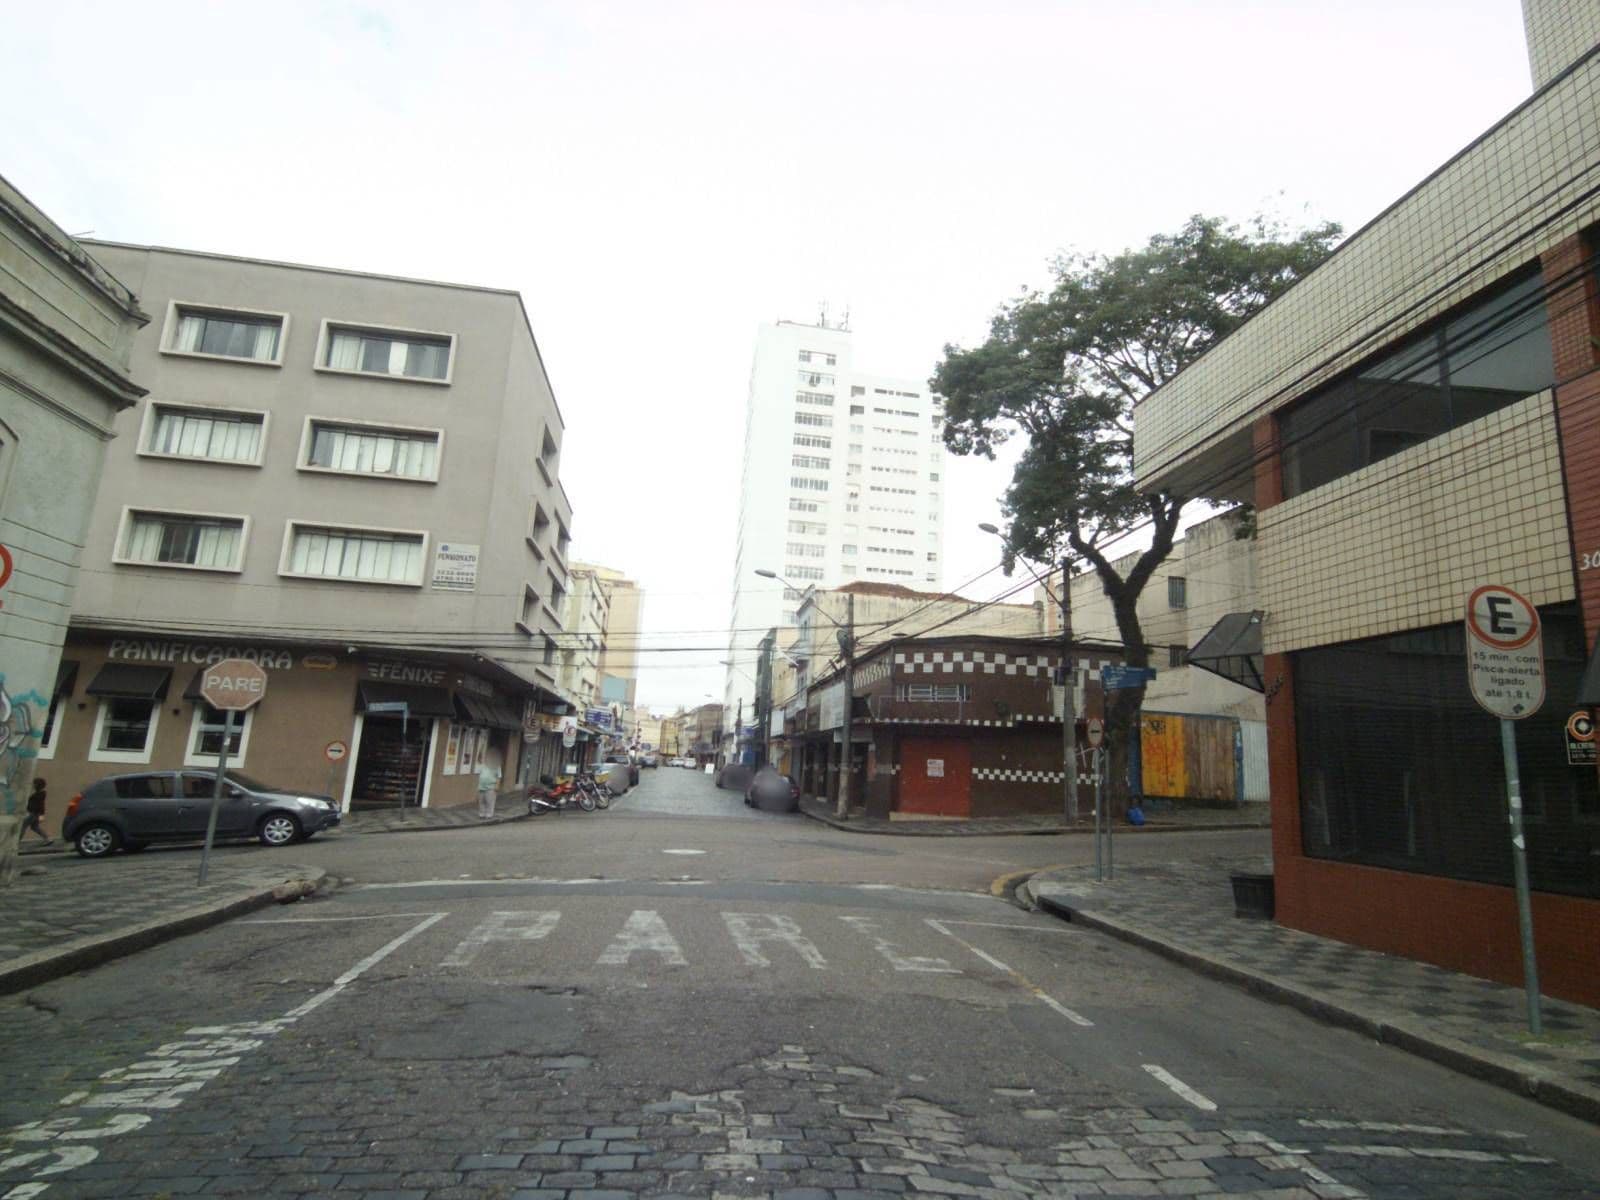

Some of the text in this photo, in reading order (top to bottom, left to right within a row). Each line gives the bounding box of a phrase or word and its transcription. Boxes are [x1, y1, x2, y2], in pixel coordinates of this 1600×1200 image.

[1487, 596, 1517, 635] E
[1474, 652, 1486, 661] 15
[1515, 655, 1539, 663] com
[206, 676, 262, 693] PARE
[1491, 675, 1525, 687] ligado
[440, 909, 964, 974] PARE
